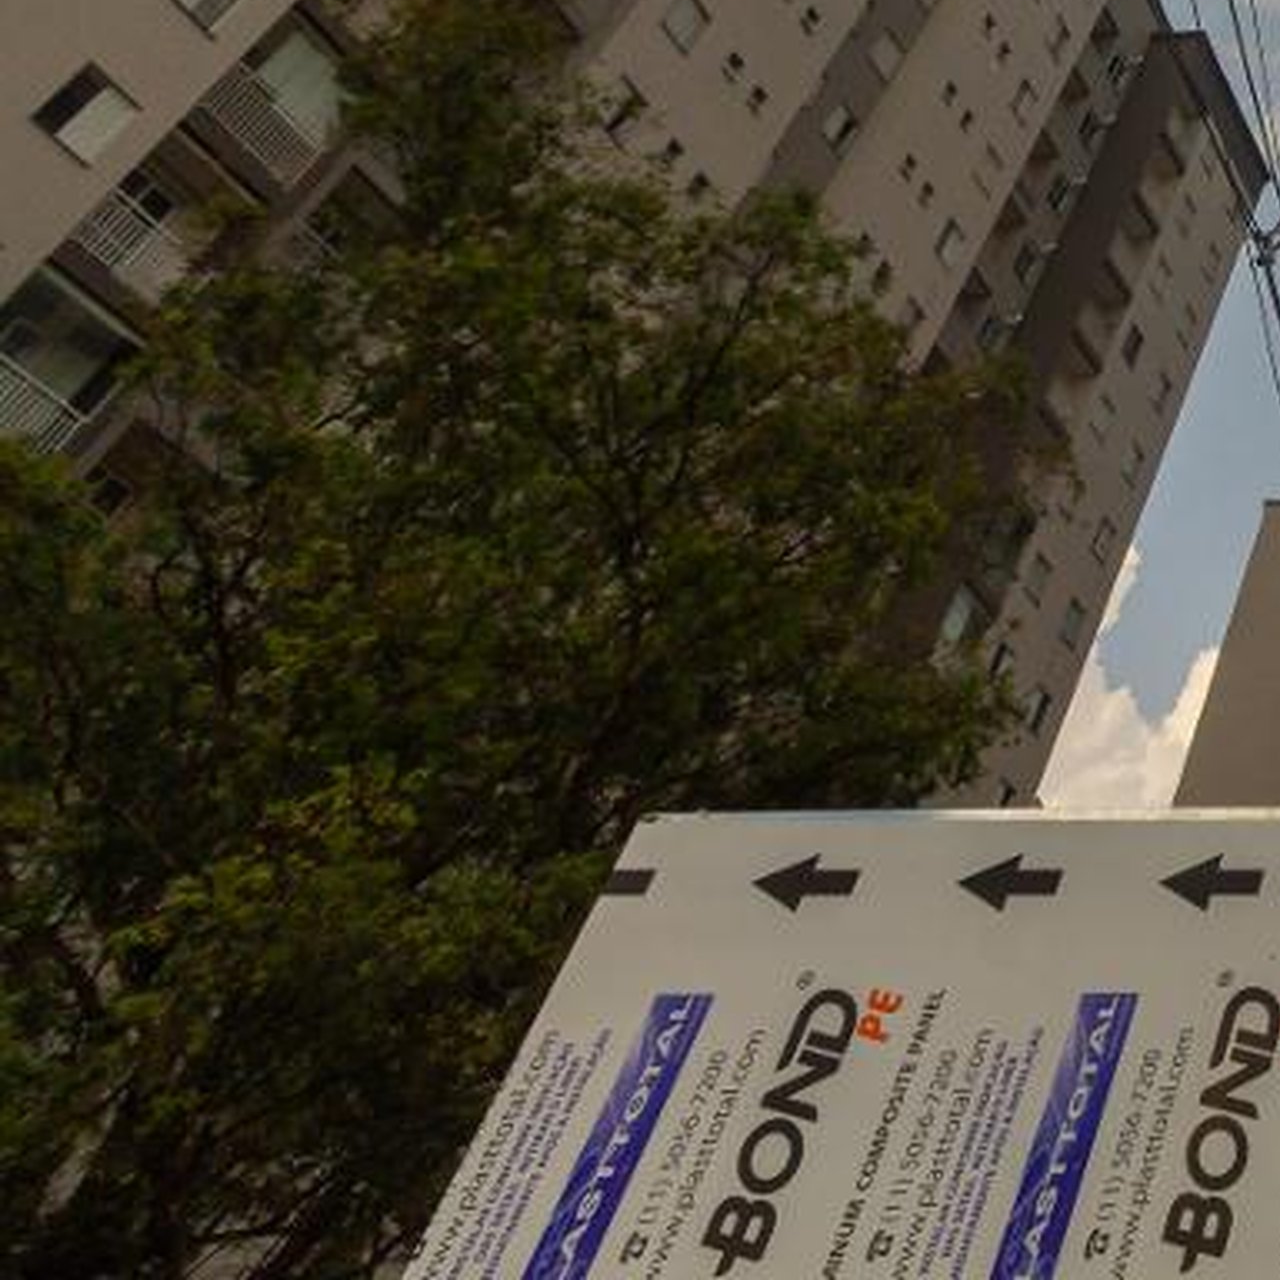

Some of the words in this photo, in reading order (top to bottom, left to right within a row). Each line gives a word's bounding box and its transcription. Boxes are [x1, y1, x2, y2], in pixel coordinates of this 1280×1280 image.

[856, 989, 903, 1043] PE
[853, 1064, 917, 1191] COMPOSITE
[905, 989, 948, 1053] PANEL
